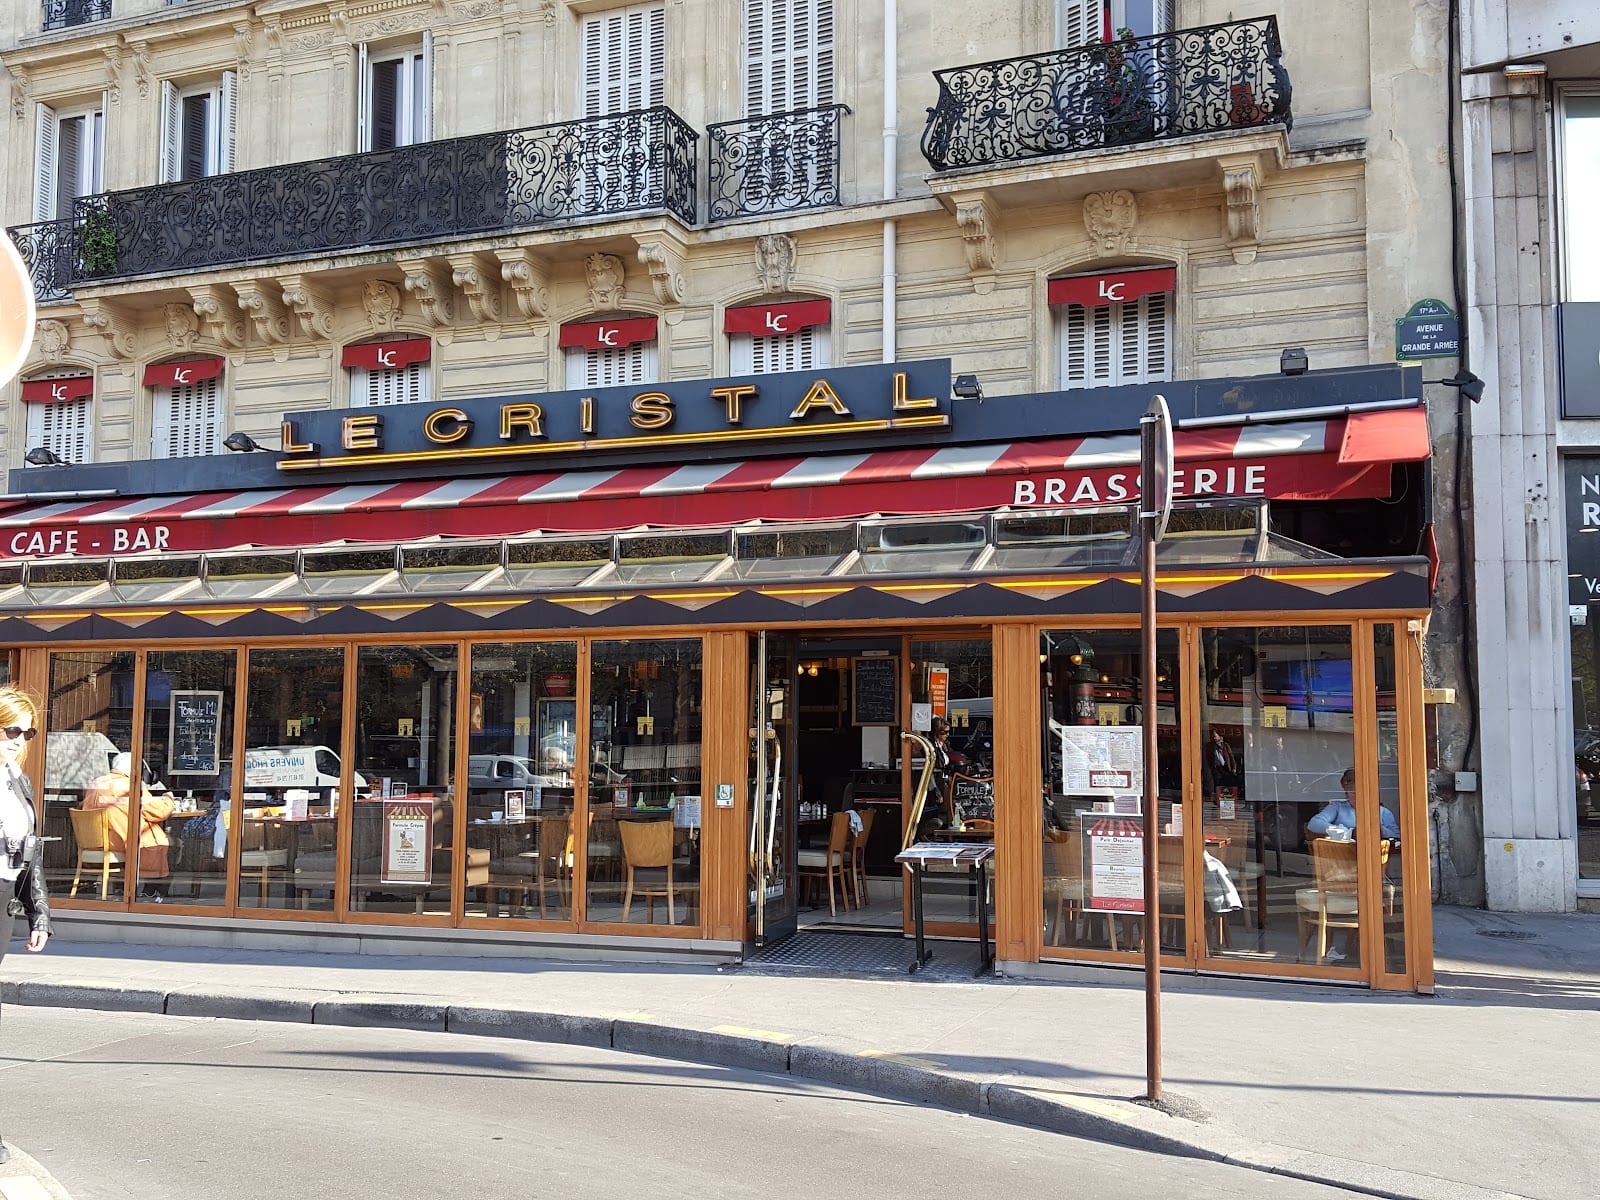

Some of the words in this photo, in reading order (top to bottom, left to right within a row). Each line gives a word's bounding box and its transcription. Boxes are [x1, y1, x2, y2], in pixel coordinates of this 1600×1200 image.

[1099, 280, 1125, 300] LC
[766, 311, 788, 331] LC
[1416, 323, 1443, 333] AVENUE
[598, 326, 619, 346] LC
[1401, 342, 1431, 352] GRANDE
[1434, 339, 1458, 350] ARMÉE
[377, 348, 397, 367] LC
[174, 367, 192, 383] LC
[51, 383, 68, 400] LC
[281, 414, 384, 454] LE
[423, 372, 937, 445] CRISTAL
[1014, 465, 1266, 505] BRASERIE
[10, 530, 79, 554] CAFE
[113, 525, 170, 552] BAR
